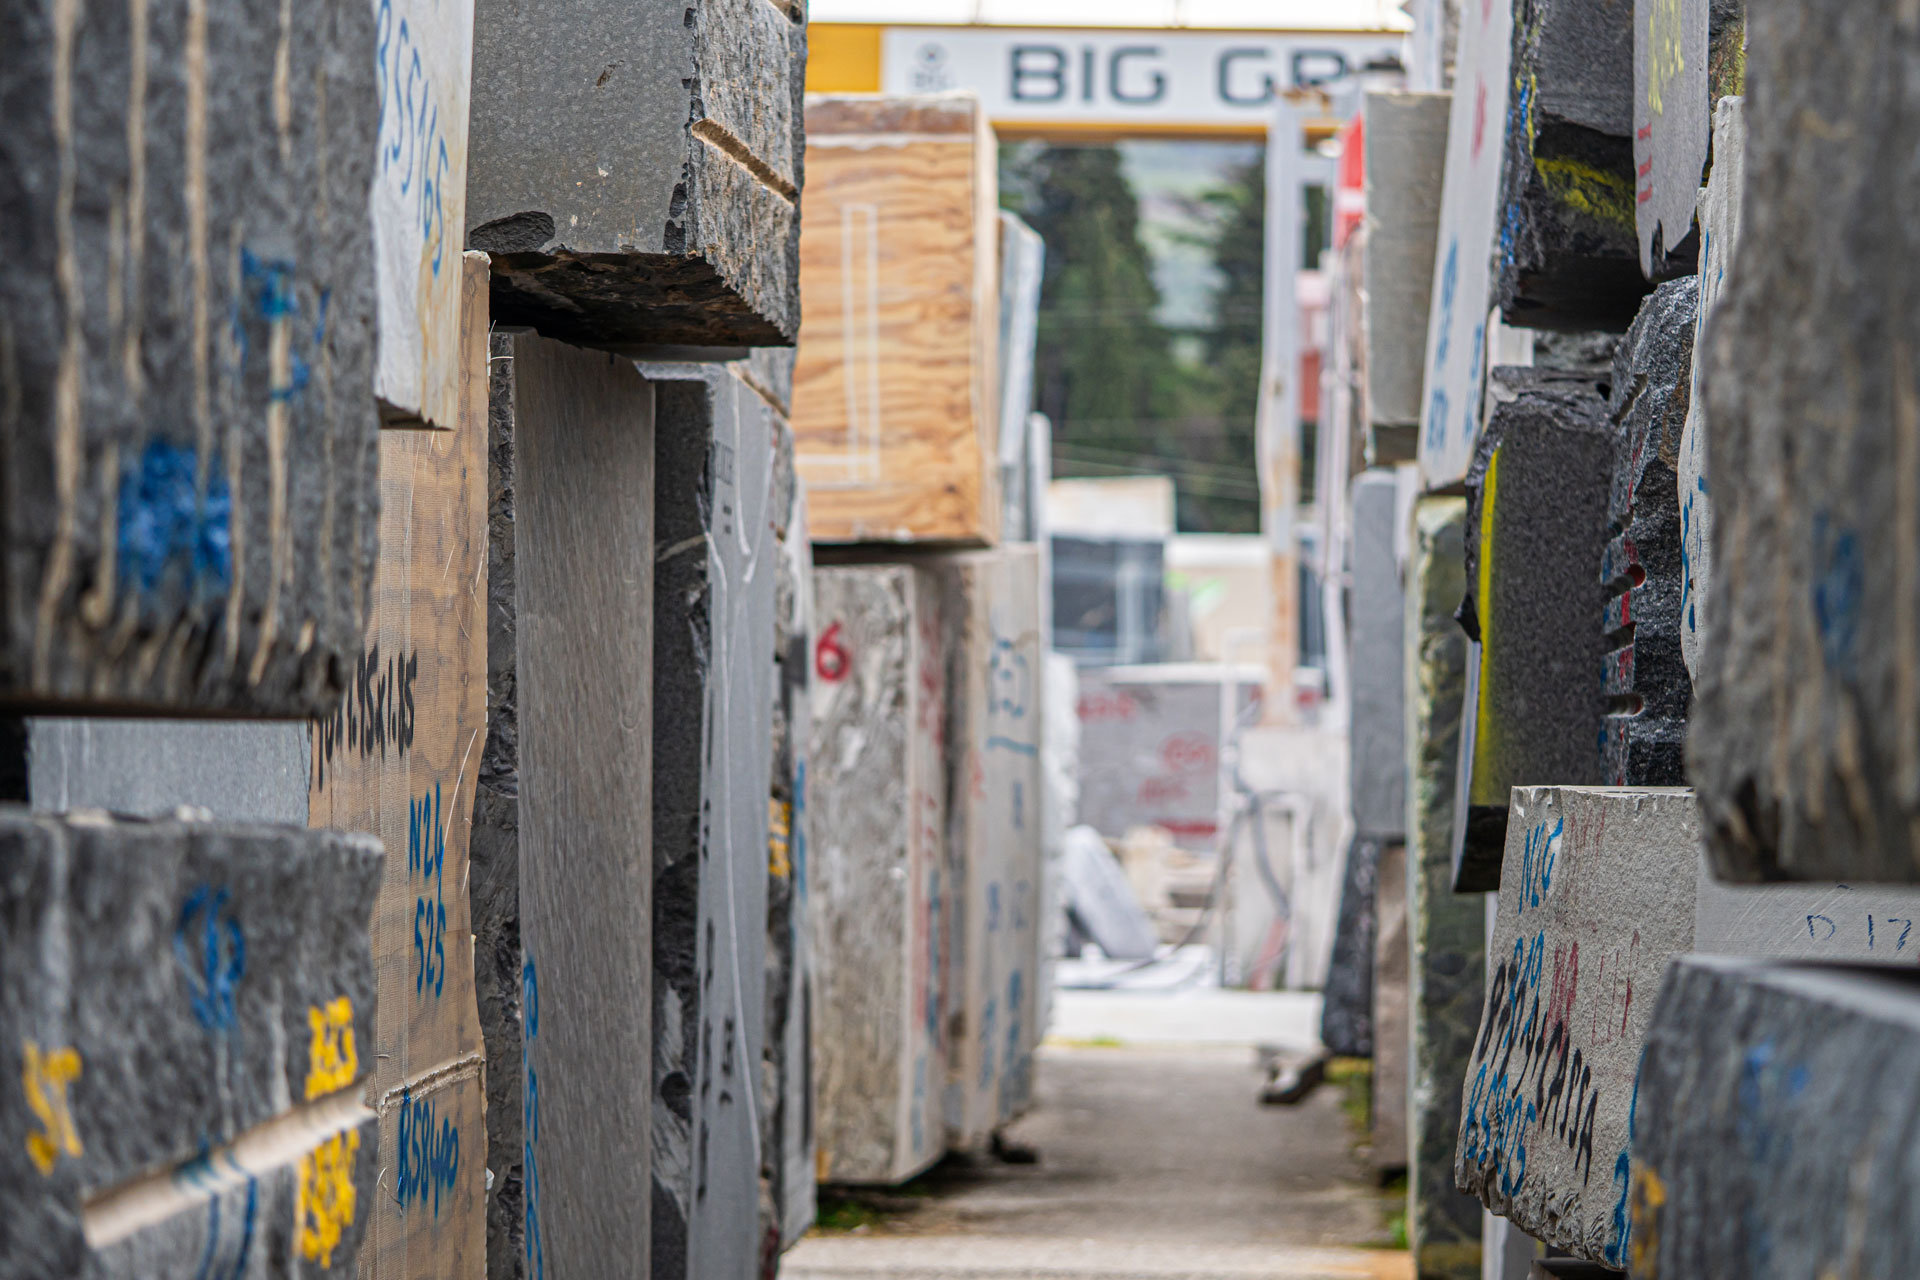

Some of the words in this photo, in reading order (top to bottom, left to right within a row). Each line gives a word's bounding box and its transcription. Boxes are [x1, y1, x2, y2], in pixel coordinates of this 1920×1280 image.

[1009, 44, 1168, 105] BIG
[1217, 46, 1352, 107] GR
[814, 621, 851, 683] 6
